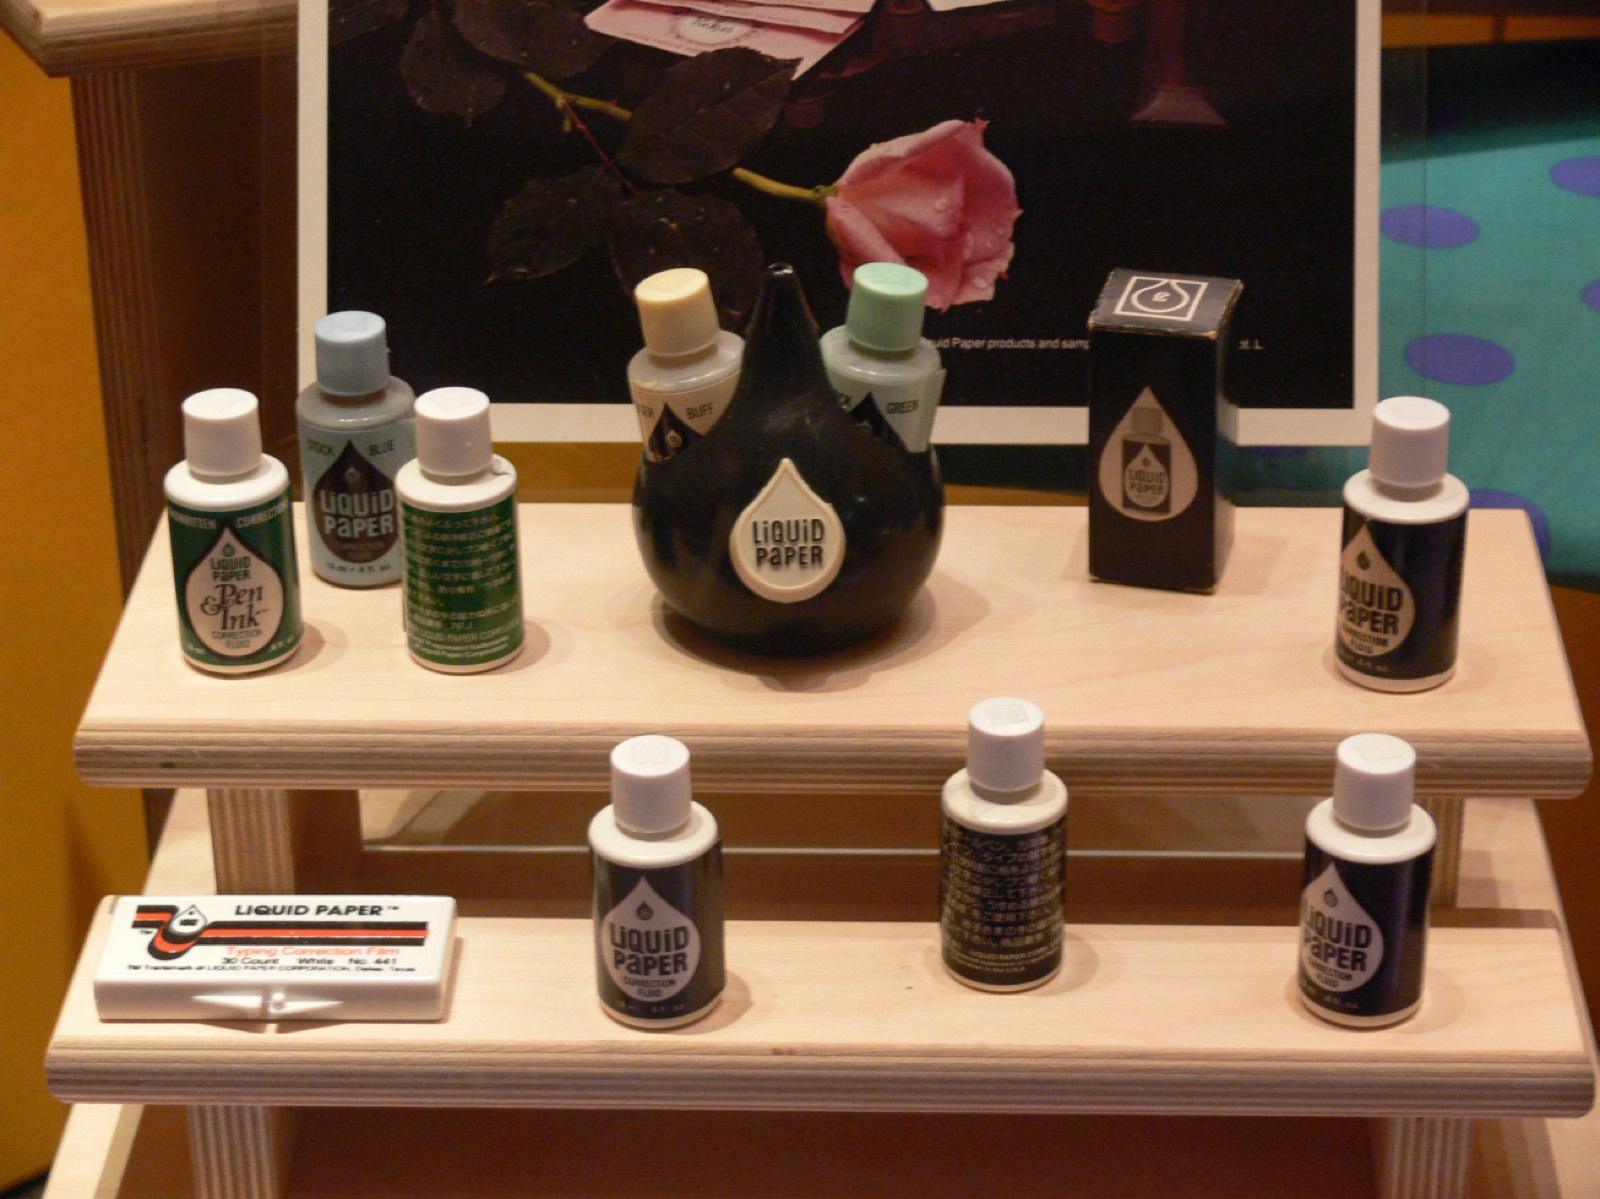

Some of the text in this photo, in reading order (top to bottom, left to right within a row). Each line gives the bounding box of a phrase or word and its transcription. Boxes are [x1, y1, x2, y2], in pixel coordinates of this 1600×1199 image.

[952, 337, 986, 351] Paper
[987, 338, 1035, 351] products
[1039, 338, 1060, 349] and
[886, 399, 919, 415] GREEN
[369, 439, 395, 457] BLUE
[213, 583, 264, 606] Pen
[233, 904, 310, 917] LIQUID
[314, 904, 383, 917] PAPER
[225, 945, 400, 959] Typing Correction Film
[240, 957, 280, 966] Count
[298, 957, 335, 966] White
[623, 975, 677, 989] CORRECTION
[638, 987, 663, 998] FLUID
